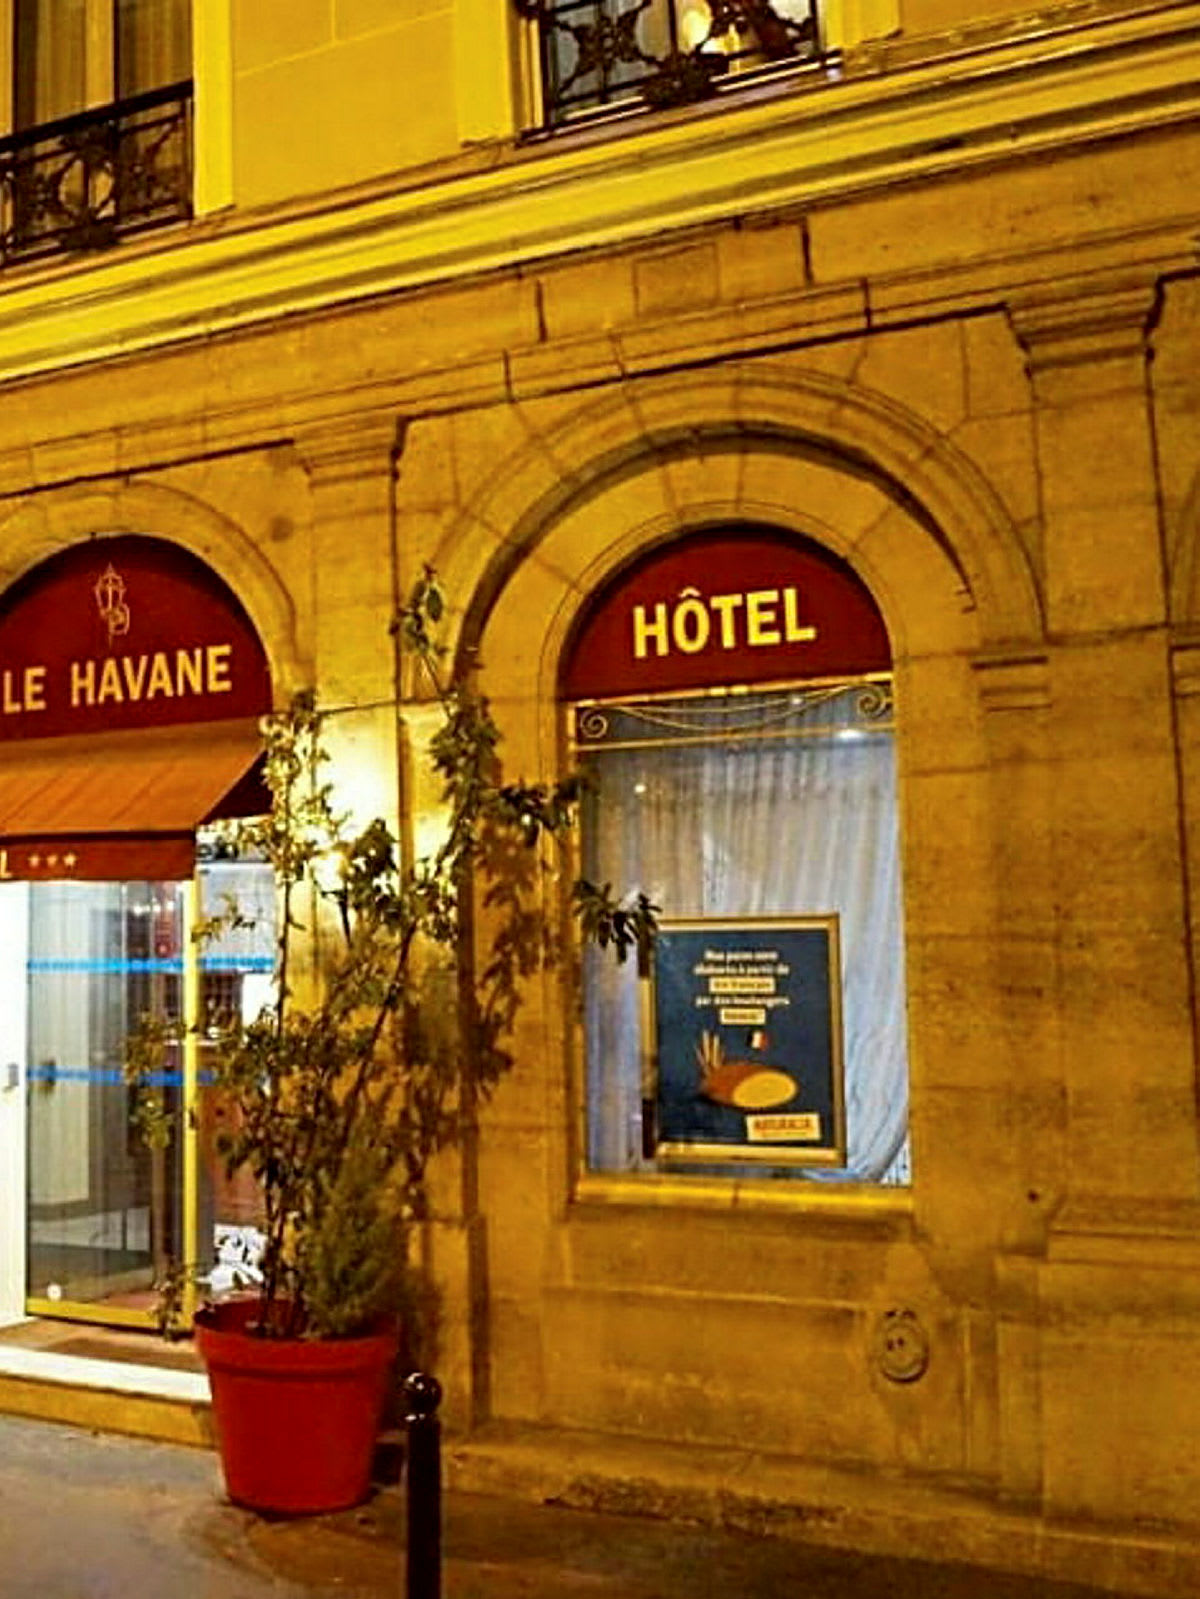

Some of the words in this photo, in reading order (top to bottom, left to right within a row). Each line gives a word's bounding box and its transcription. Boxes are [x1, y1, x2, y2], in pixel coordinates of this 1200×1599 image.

[633, 586, 817, 659] HÔTEL
[3, 661, 47, 714] LE
[71, 644, 232, 707] HAVANE
